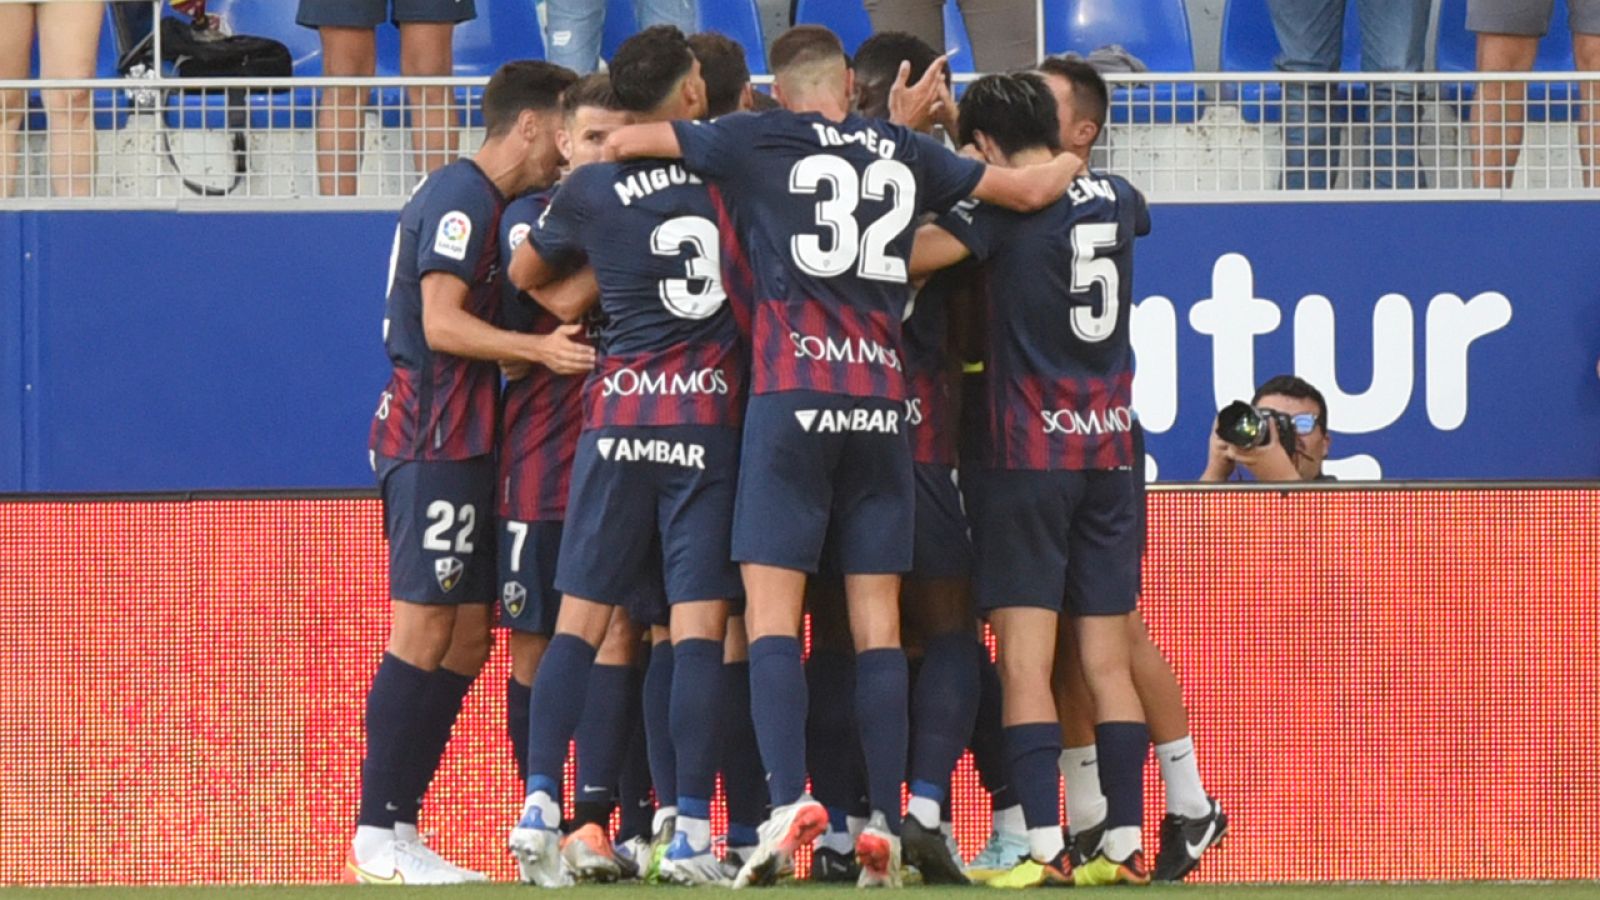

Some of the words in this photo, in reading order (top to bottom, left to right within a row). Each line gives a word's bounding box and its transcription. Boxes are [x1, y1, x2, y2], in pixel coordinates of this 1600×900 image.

[789, 153, 917, 283] 32
[650, 215, 727, 320] 3
[1070, 222, 1119, 343] 5
[1041, 405, 1134, 435] SOMMO
[614, 438, 706, 470] AMBAR
[423, 499, 476, 554] 22
[507, 520, 528, 572] 7
